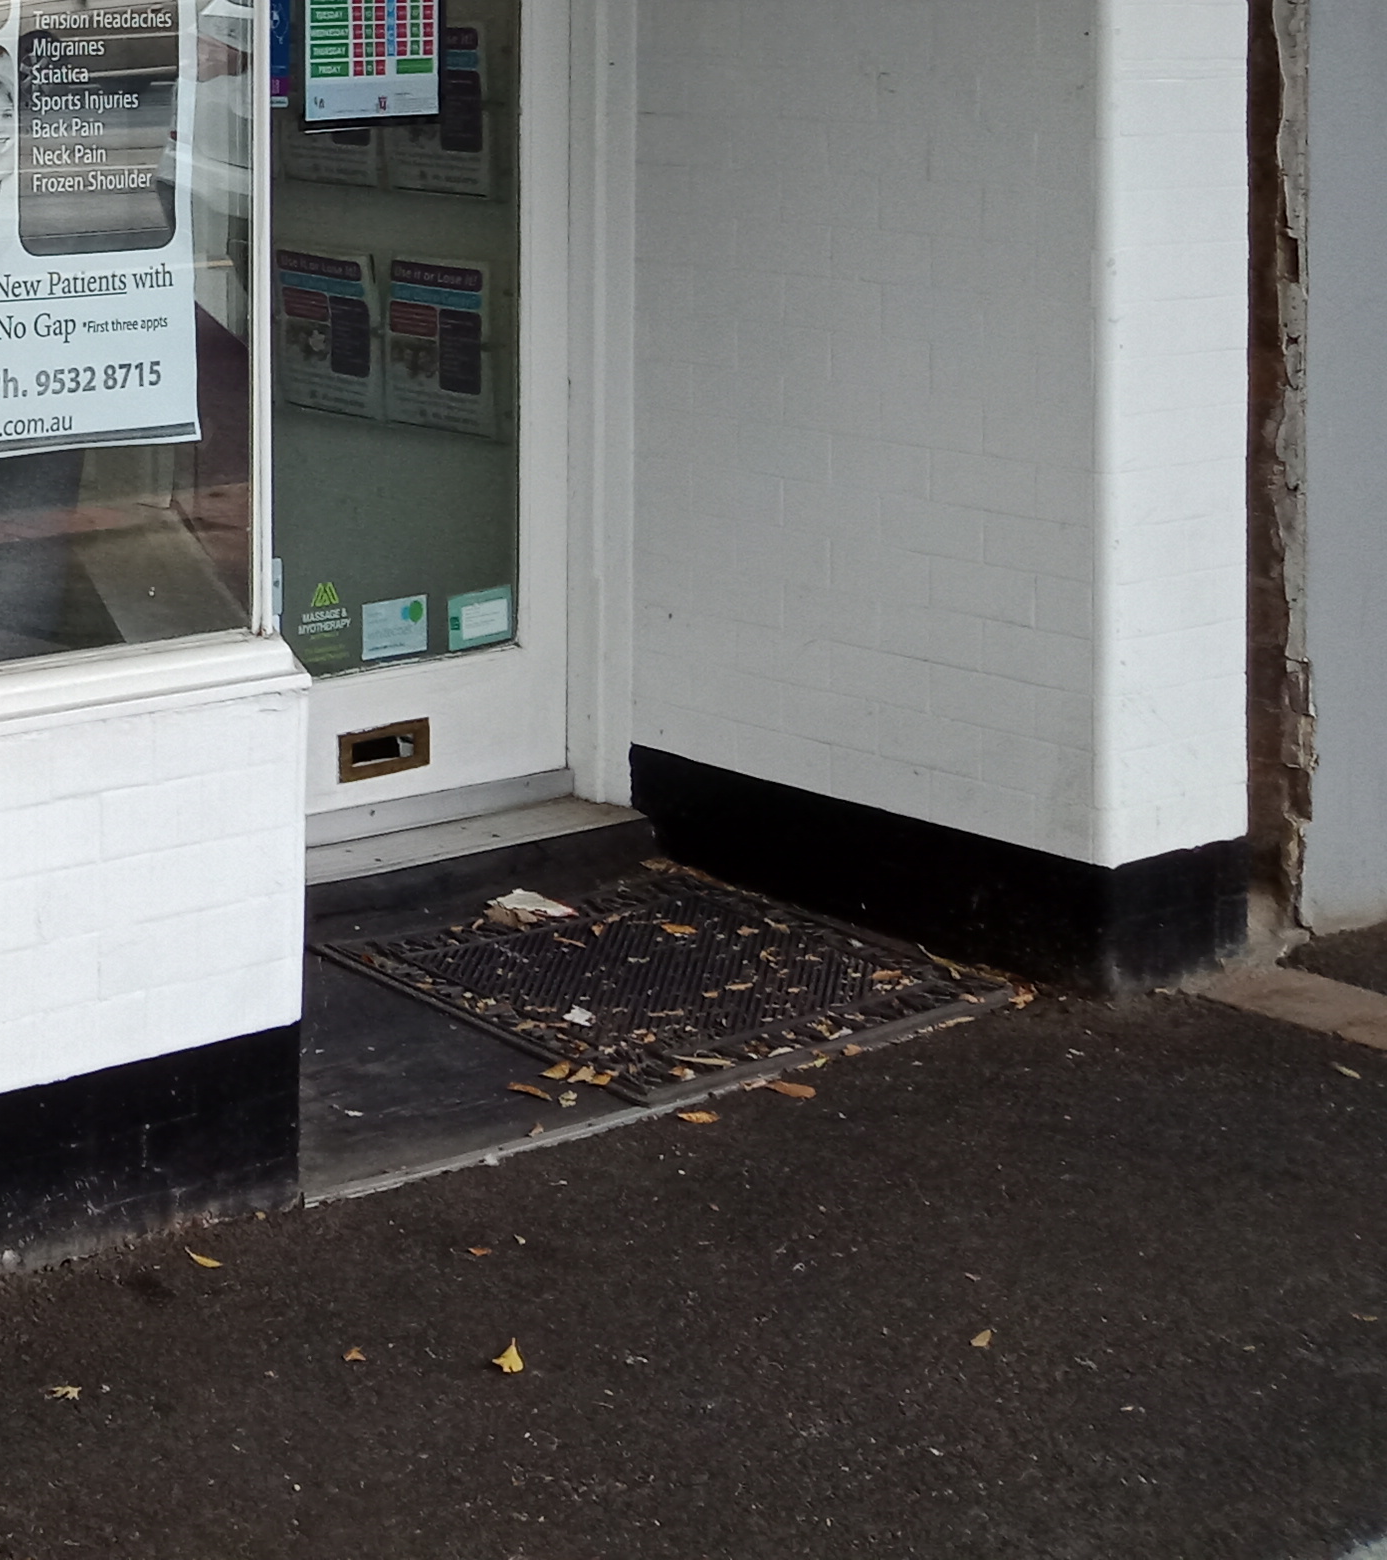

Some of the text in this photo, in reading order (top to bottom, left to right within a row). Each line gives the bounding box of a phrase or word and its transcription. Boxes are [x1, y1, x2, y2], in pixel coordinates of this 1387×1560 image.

[47, 270, 127, 294] Patients
[132, 264, 174, 290] with
[33, 313, 76, 344] Gap
[110, 319, 138, 332] three
[140, 317, 168, 331] appts
[36, 367, 96, 396] 9532
[103, 361, 162, 390] 8715
